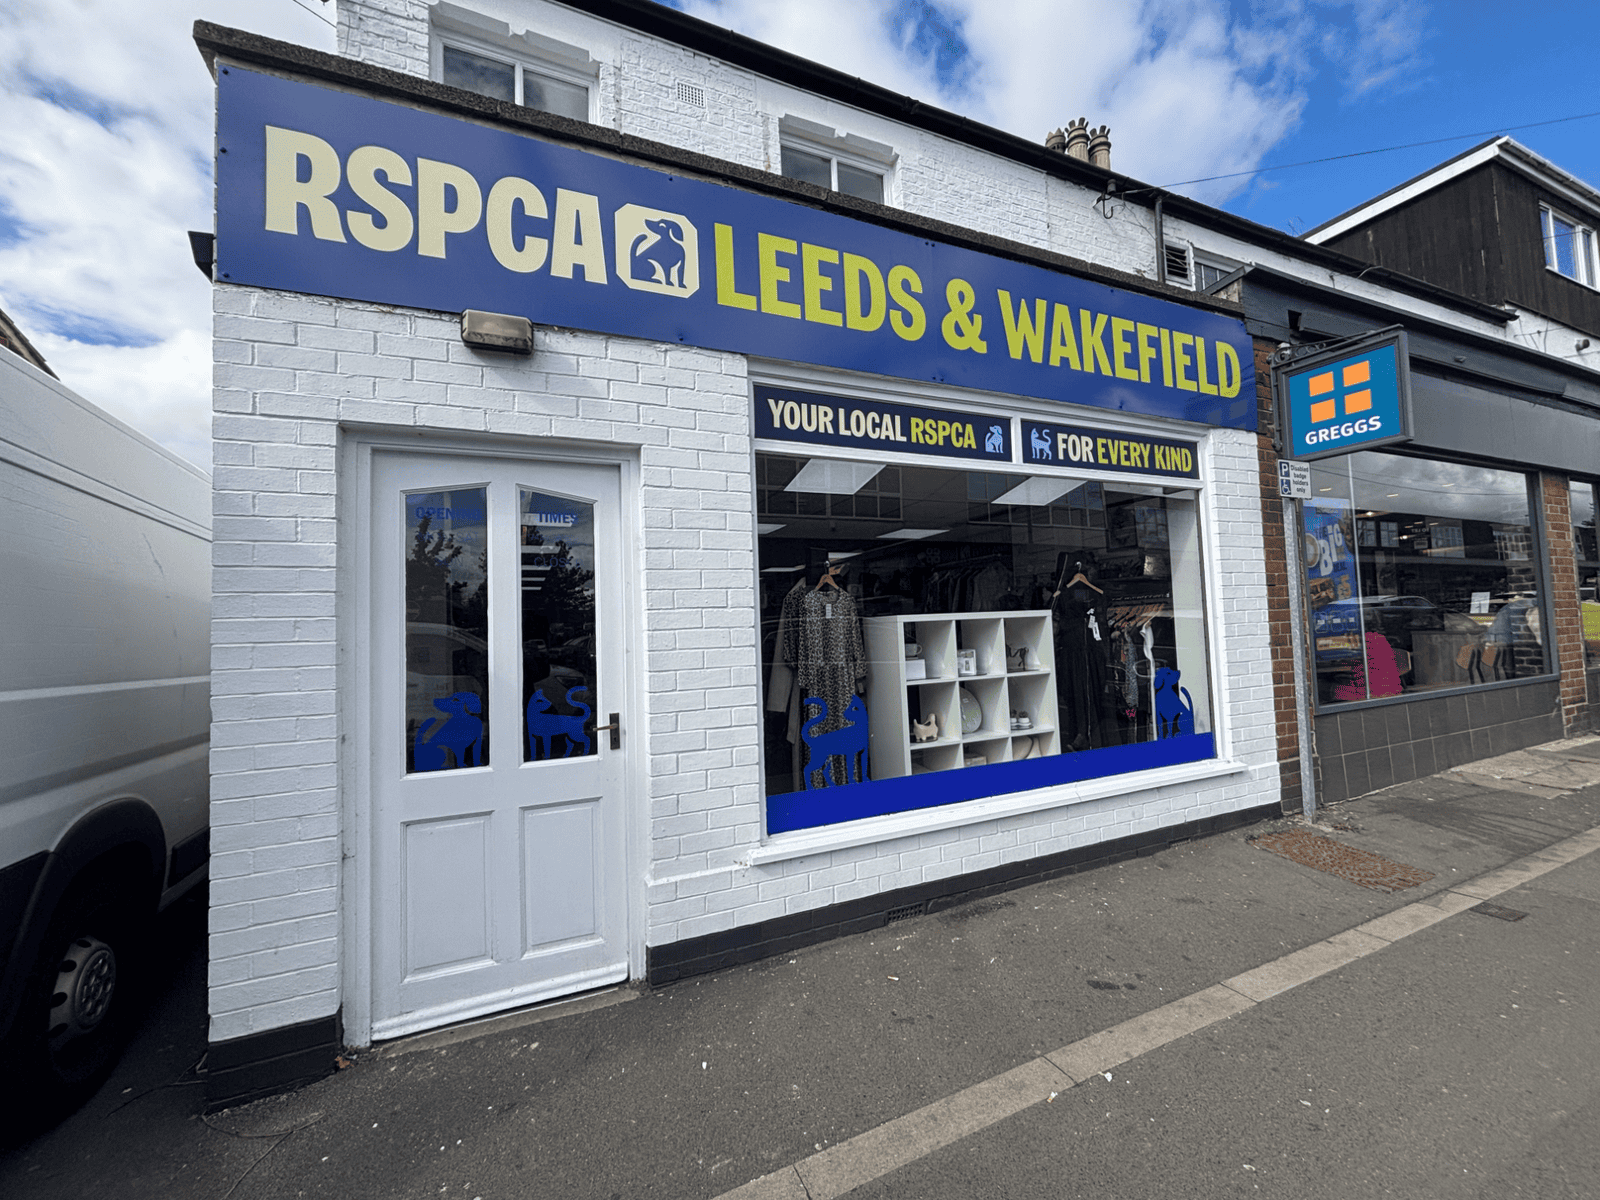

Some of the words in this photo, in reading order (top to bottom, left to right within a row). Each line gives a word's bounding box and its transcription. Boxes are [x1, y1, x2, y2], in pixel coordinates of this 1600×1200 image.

[264, 124, 608, 286] RSPCA
[714, 222, 927, 343] LEEDS
[941, 278, 988, 354] &
[997, 288, 1242, 399] WAKEFIELD
[767, 398, 835, 435] YOUR
[838, 407, 907, 443] LOCAL
[910, 417, 977, 449] RSPCA
[1304, 415, 1383, 446] GREGGS
[1056, 432, 1095, 463] FOR
[1096, 437, 1151, 469] EVERY
[1154, 444, 1192, 472] KIND
[1281, 463, 1289, 476] P
[1290, 464, 1309, 473] Disabled
[1293, 472, 1307, 480] badge
[1296, 486, 1306, 494] only
[537, 511, 578, 524] TIMES
